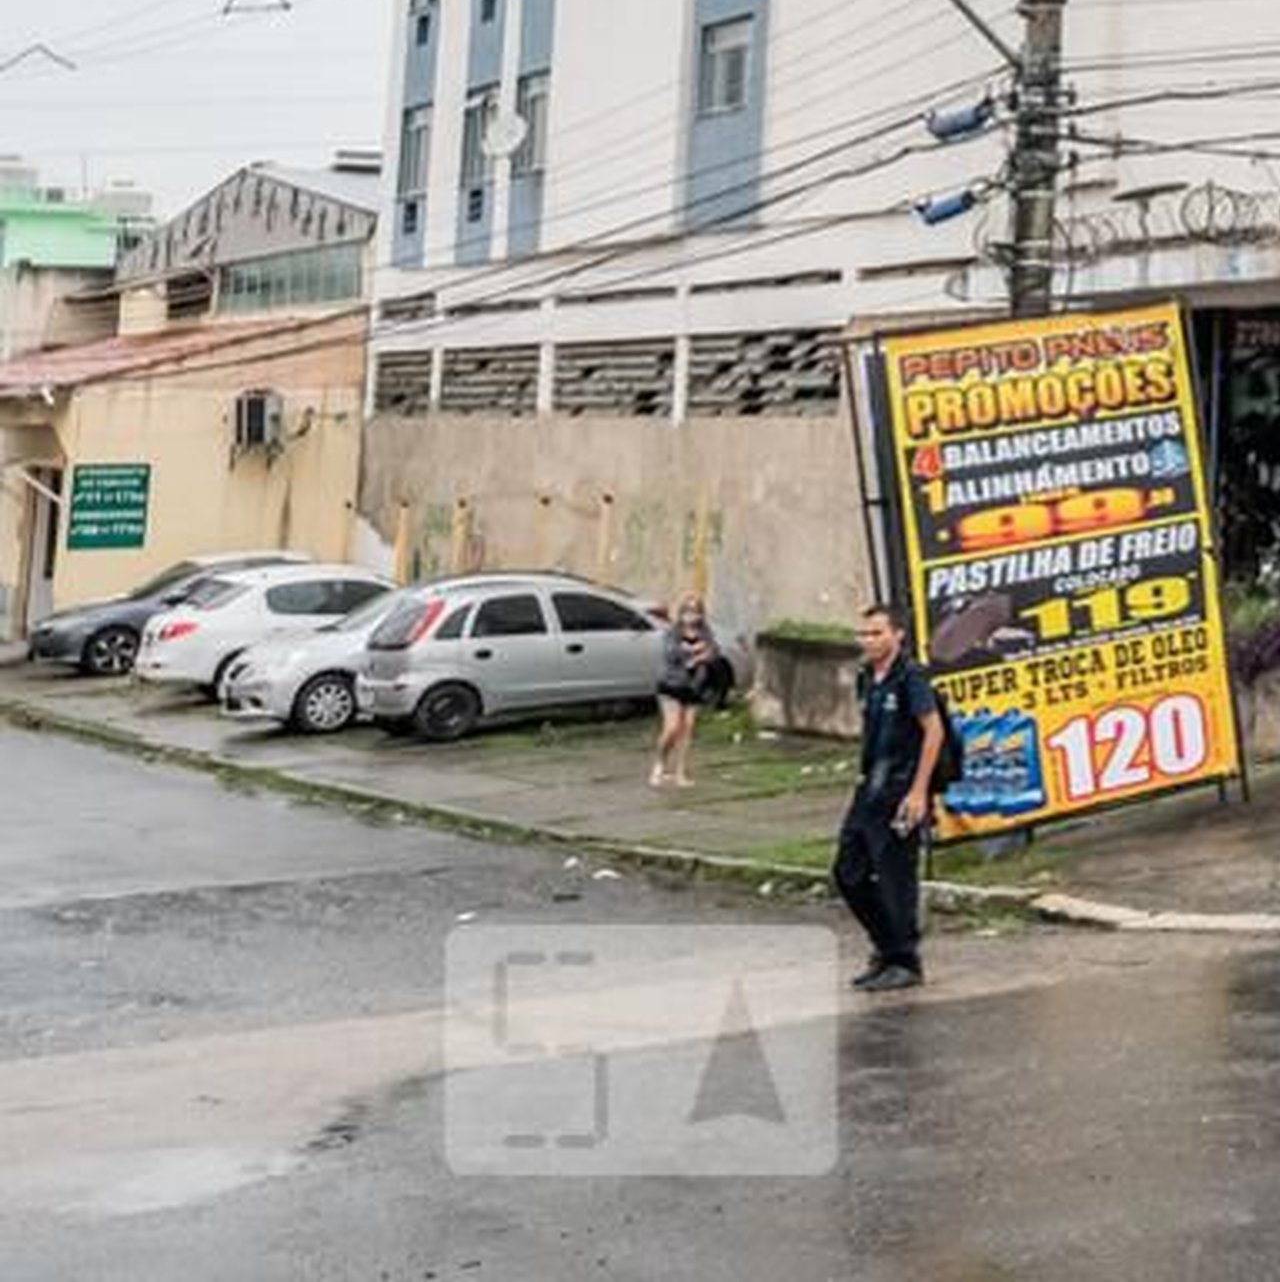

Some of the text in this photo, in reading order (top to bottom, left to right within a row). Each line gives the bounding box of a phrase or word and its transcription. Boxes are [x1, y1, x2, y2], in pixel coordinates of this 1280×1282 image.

[901, 339, 1041, 382] PEPITO
[943, 412, 1181, 469] BALANCEAMENTOS
[921, 478, 946, 515] 1
[959, 487, 1147, 549] 99
[928, 522, 1198, 600] PASTILHA DE FREIO
[1018, 575, 1193, 640] 119
[1026, 647, 1106, 688] TROCA
[1114, 635, 1147, 668] DE
[1046, 692, 1209, 803] 120
